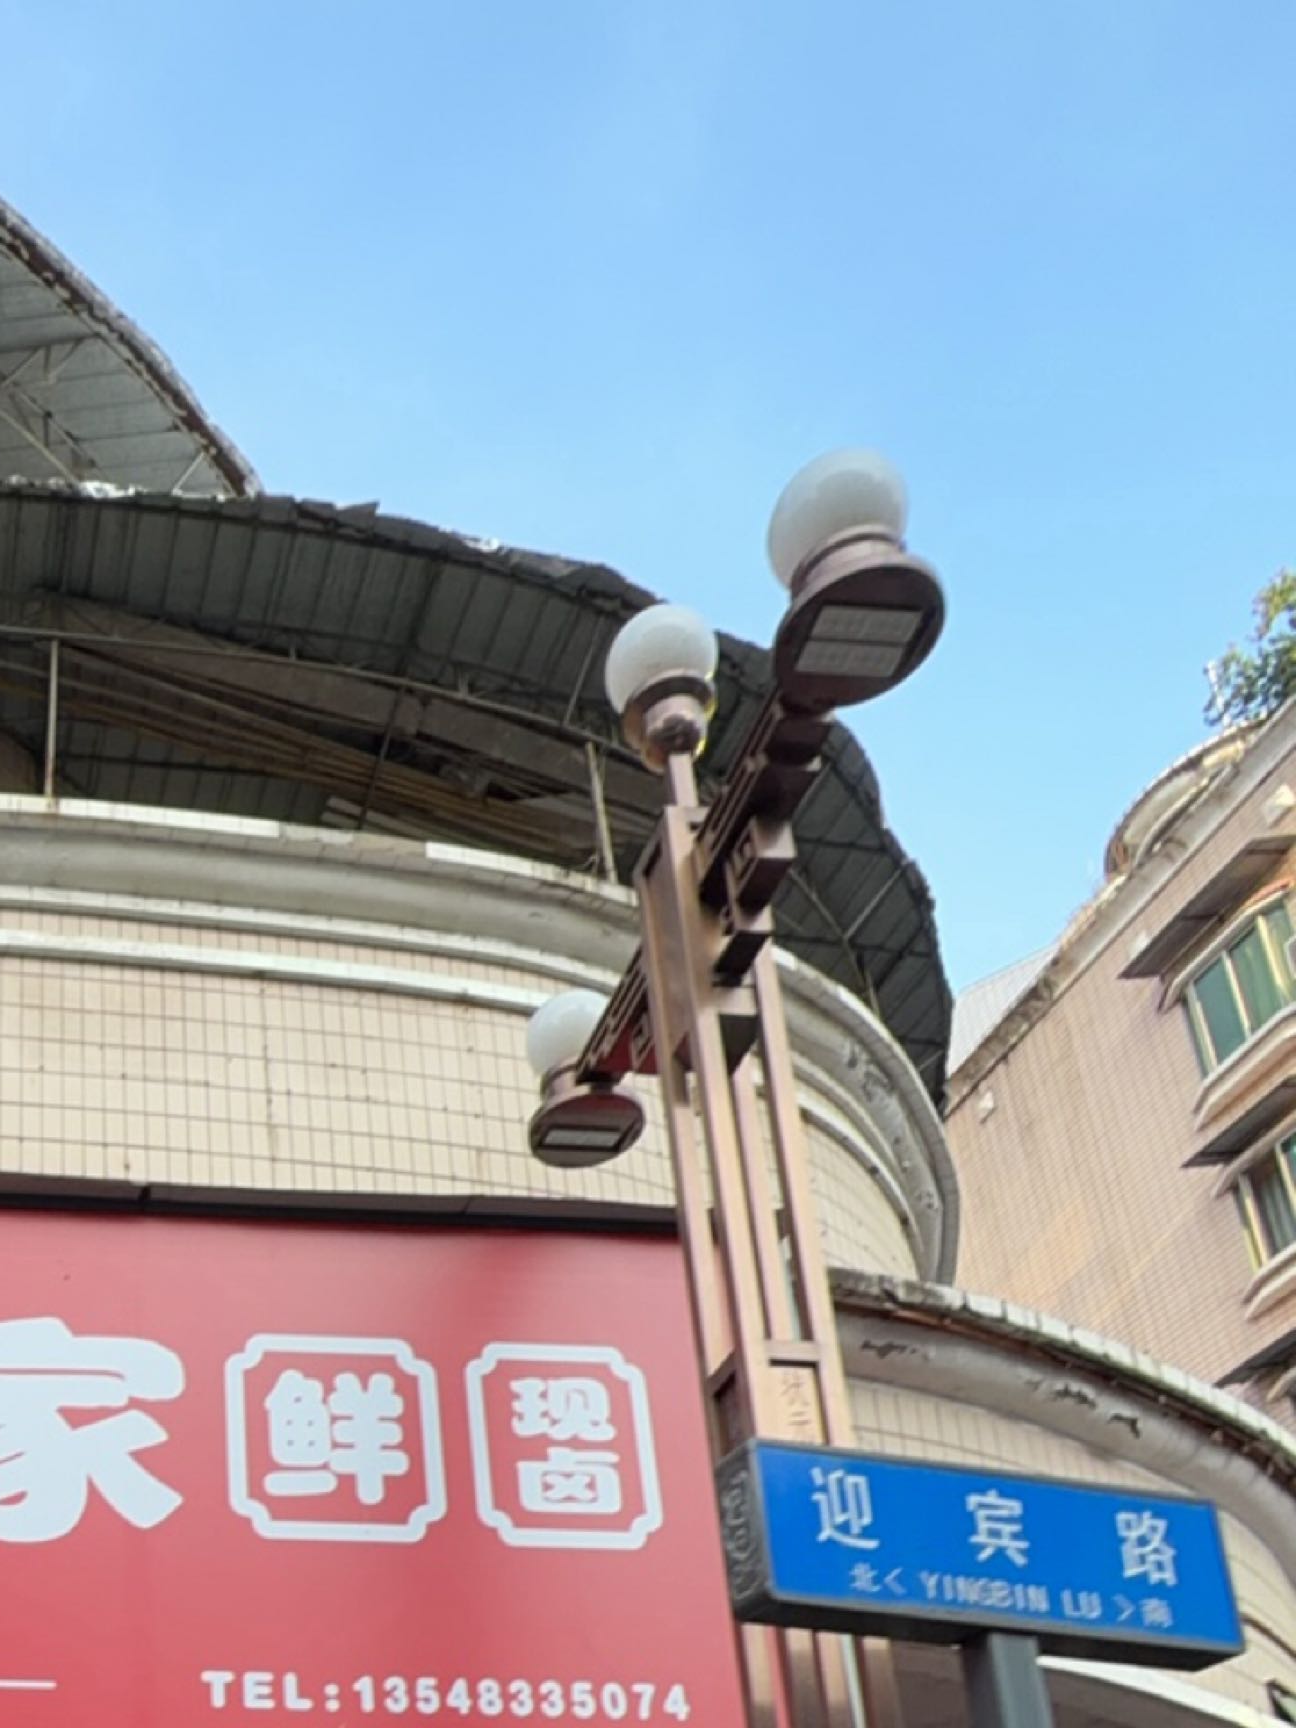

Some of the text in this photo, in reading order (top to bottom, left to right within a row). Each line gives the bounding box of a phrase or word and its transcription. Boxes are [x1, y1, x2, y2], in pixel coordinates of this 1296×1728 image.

[264, 1370, 409, 1505] 鲜
[510, 1377, 621, 1514] 现卤
[812, 1468, 1178, 1587] 迎宾路
[851, 1563, 883, 1593] 北
[920, 1572, 1049, 1613] YINGBIN
[1062, 1591, 1101, 1620] LU
[201, 1671, 691, 1720] TEL:13548335074
